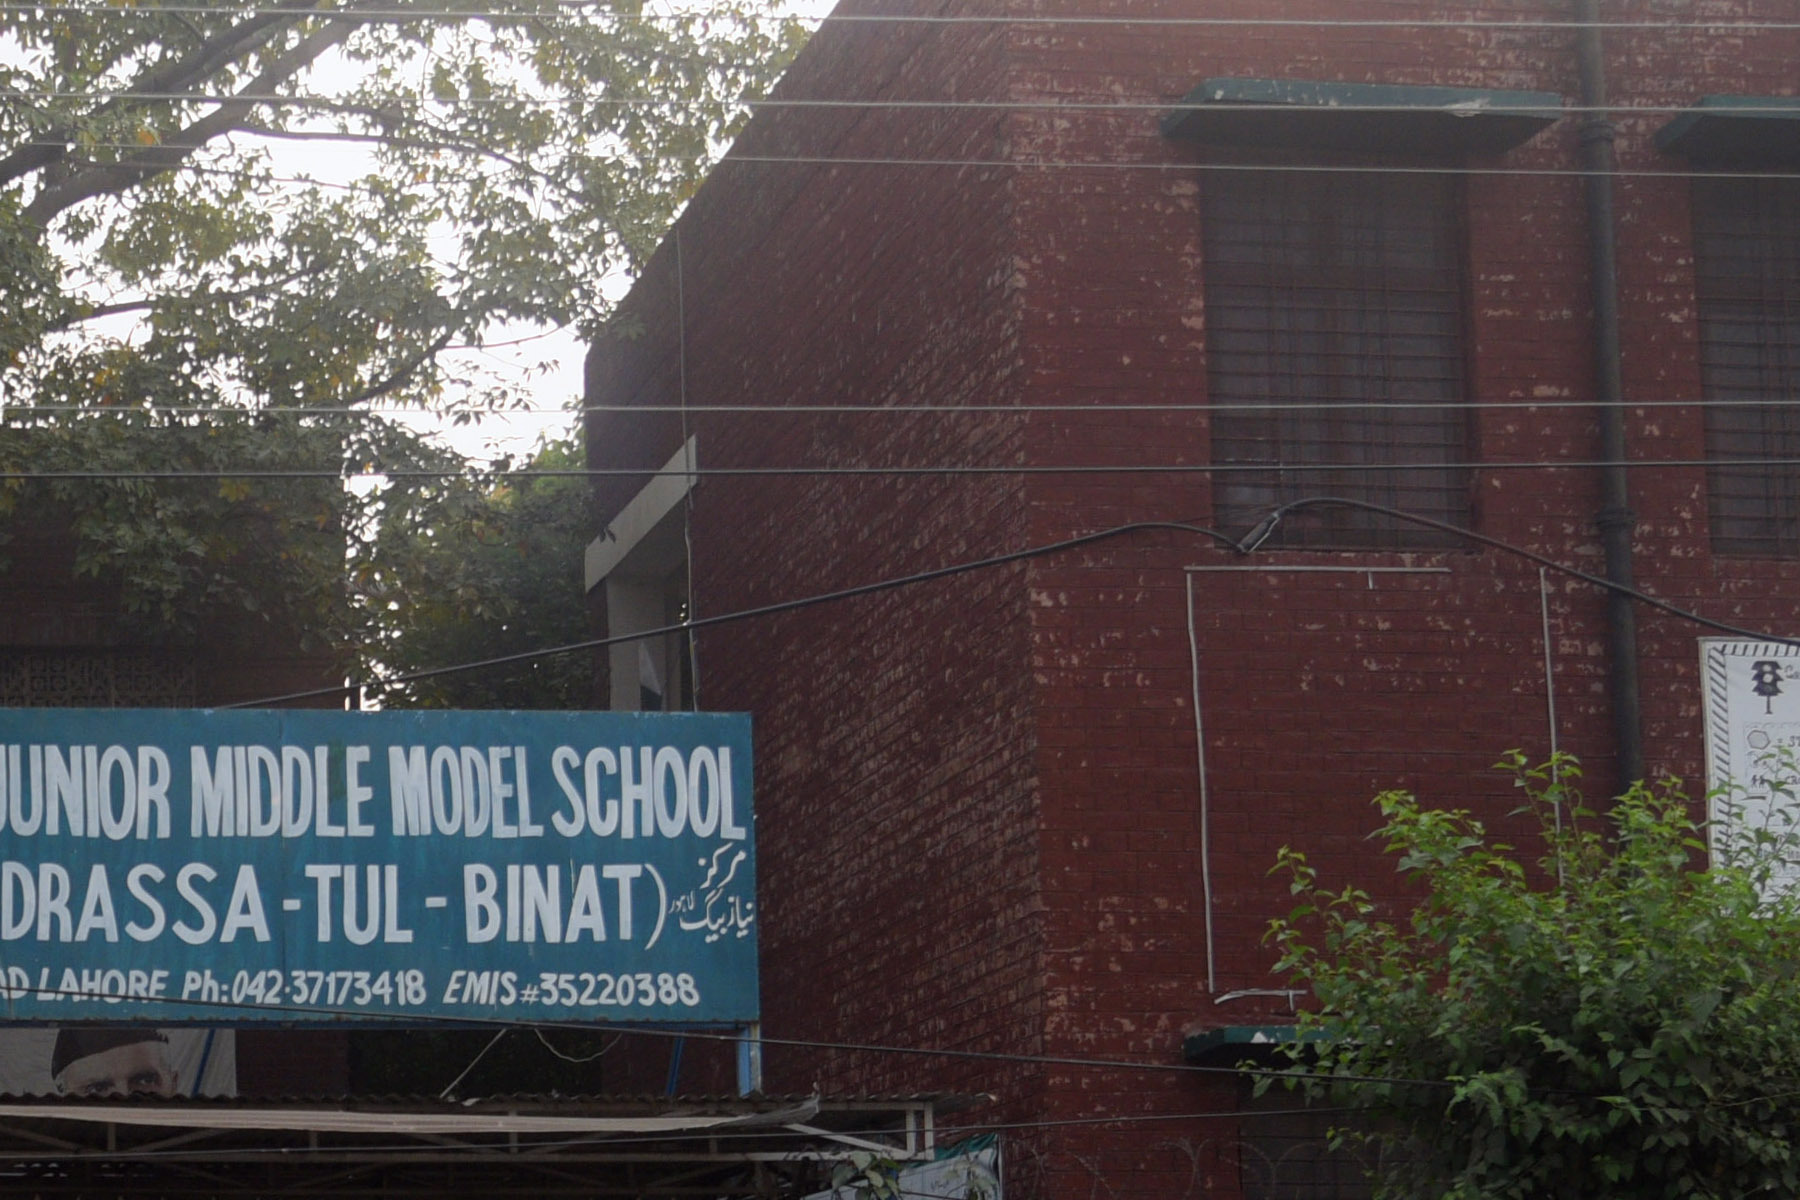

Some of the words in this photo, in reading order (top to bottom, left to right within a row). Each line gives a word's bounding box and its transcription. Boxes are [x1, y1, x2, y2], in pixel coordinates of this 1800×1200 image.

[189, 744, 374, 838] MIDDLE
[387, 745, 544, 838] MODEL
[551, 745, 747, 841] SCHOOL
[697, 842, 747, 890] مرکز
[36, 966, 170, 1004] LAHORE
